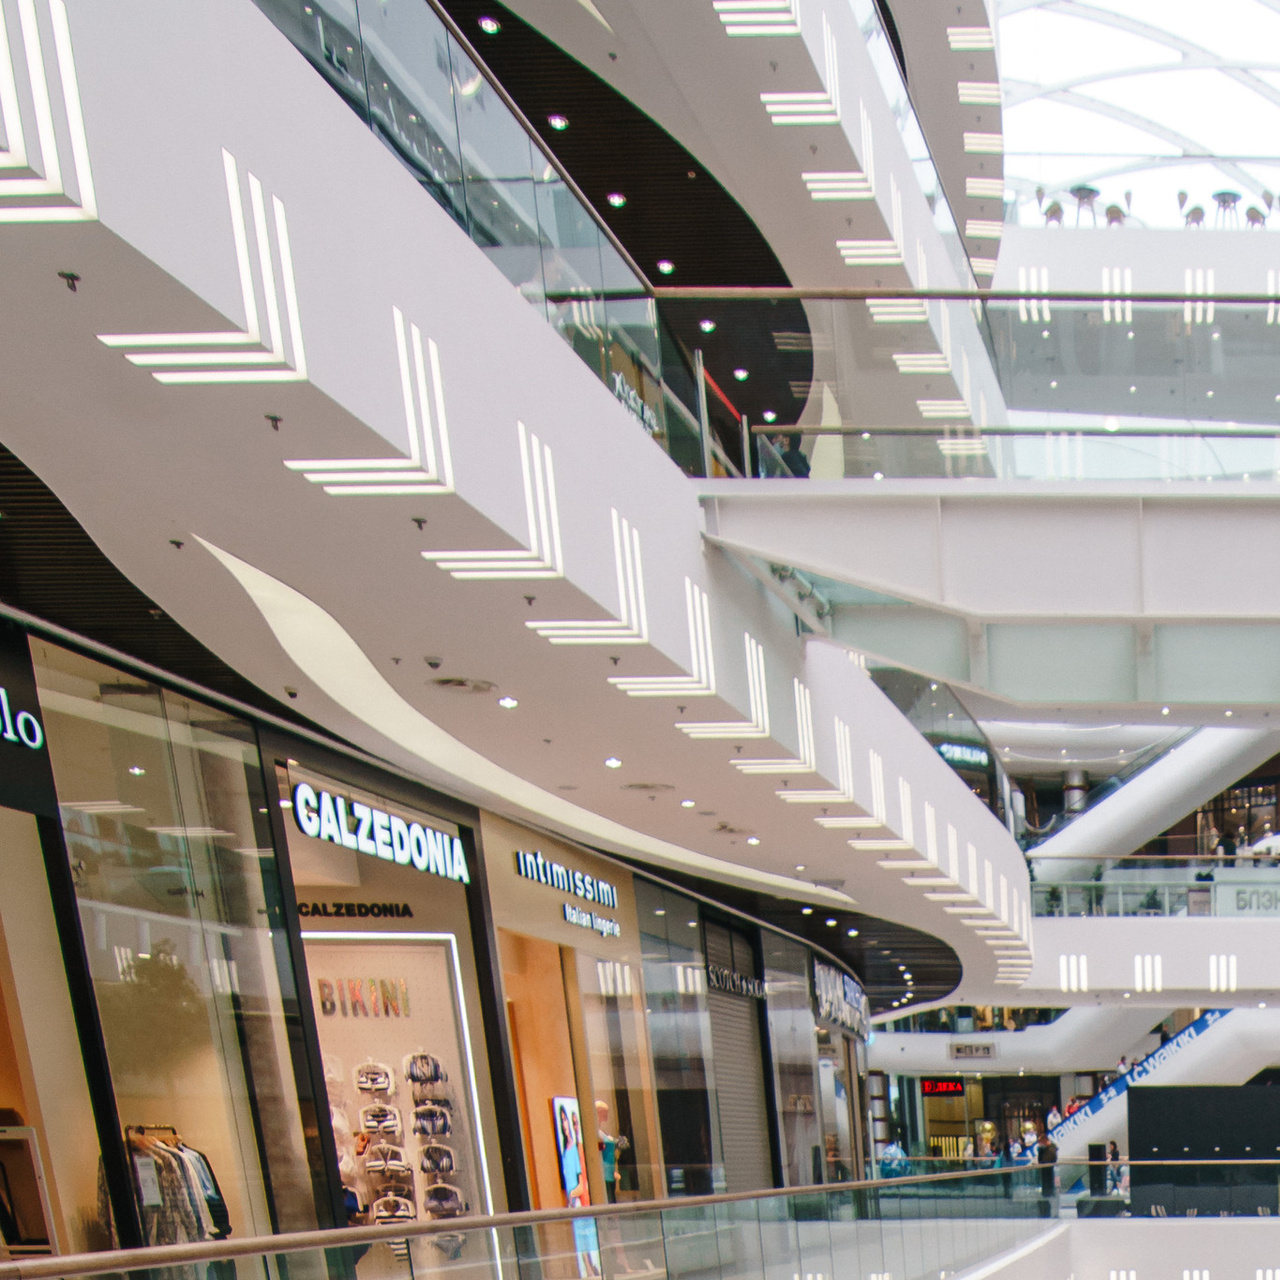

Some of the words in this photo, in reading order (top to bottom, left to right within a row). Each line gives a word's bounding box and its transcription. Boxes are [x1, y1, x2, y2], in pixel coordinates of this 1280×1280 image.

[0, 687, 43, 749] lo
[295, 782, 470, 884] CALZEDONIA
[517, 851, 618, 909] intimissimi
[297, 903, 413, 918] CALZEDONIA
[317, 978, 410, 1018] BIKINI
